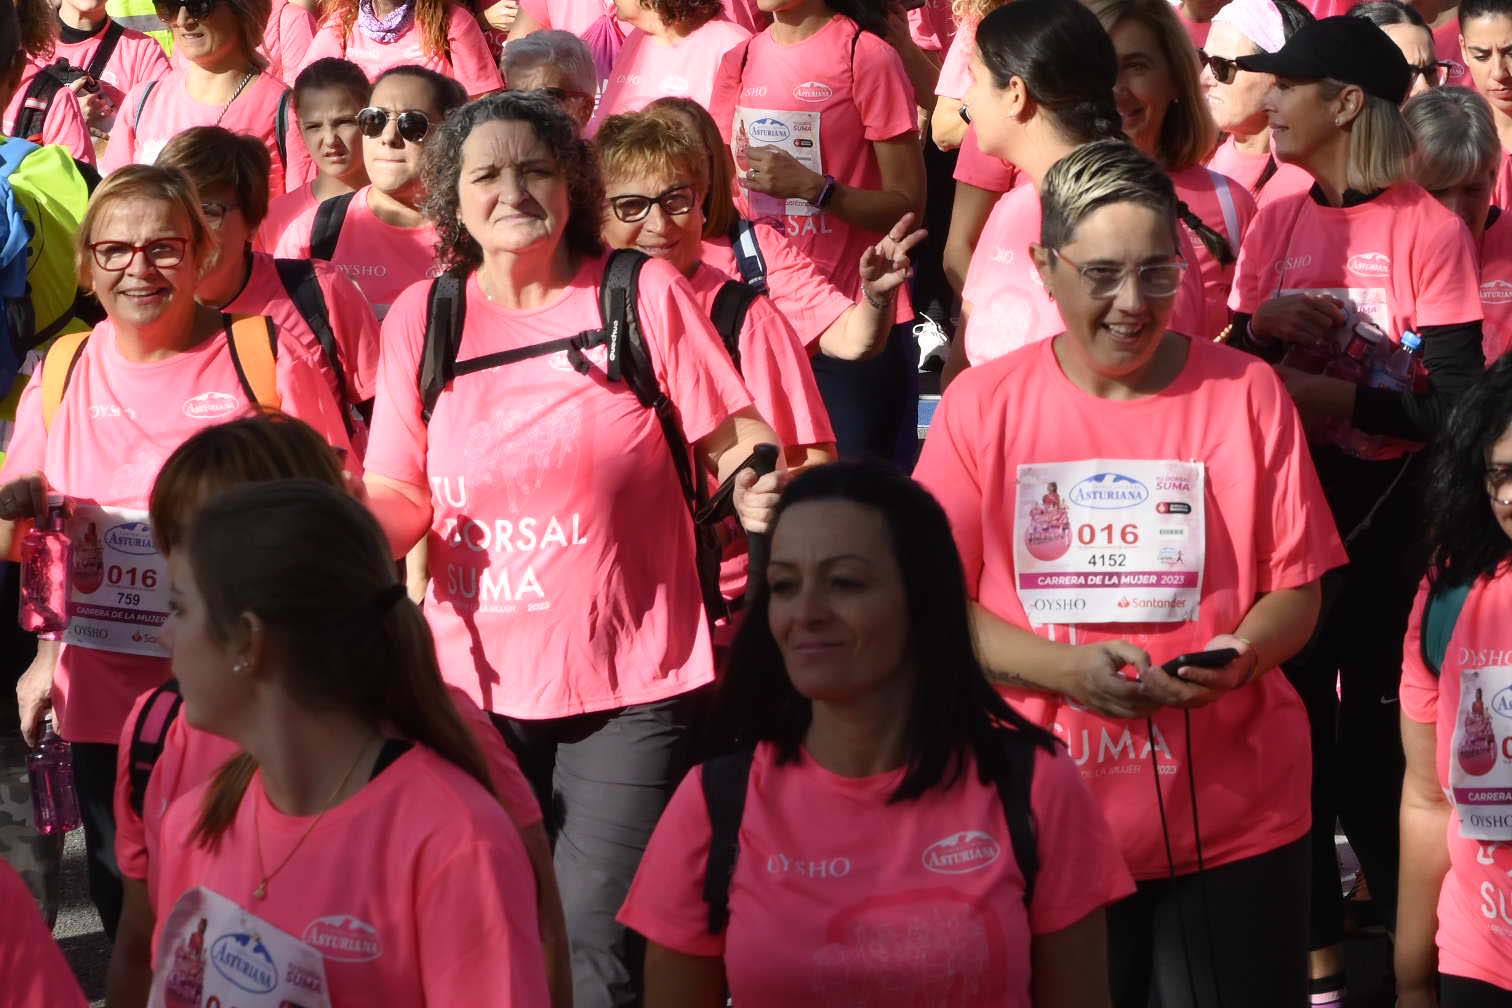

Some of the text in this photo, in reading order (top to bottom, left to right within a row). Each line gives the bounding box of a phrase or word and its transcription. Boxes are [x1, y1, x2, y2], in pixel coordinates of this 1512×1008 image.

[752, 126, 788, 137] ASTURIANA
[432, 476, 467, 508] TU
[1156, 482, 1191, 491] SUMA
[1076, 488, 1143, 501] ASTURIANA
[445, 513, 588, 553] DORSAL
[1078, 523, 1139, 545] 016
[1088, 554, 1127, 567] 4152
[107, 566, 157, 587] 016
[448, 564, 545, 601] SUMA
[1038, 575, 1185, 585] CARRERA DE LA MUJER 2023
[117, 592, 140, 605] 759
[1035, 597, 1187, 611] OYSHO Santander
[77, 607, 111, 617] CARRERA
[112, 610, 123, 619] DE
[125, 612, 136, 620] LA
[74, 624, 108, 639] OYSHO
[1468, 792, 1512, 801] CARRERA
[930, 845, 995, 867] ASTURIANA
[213, 943, 273, 988] ASTURIANA
